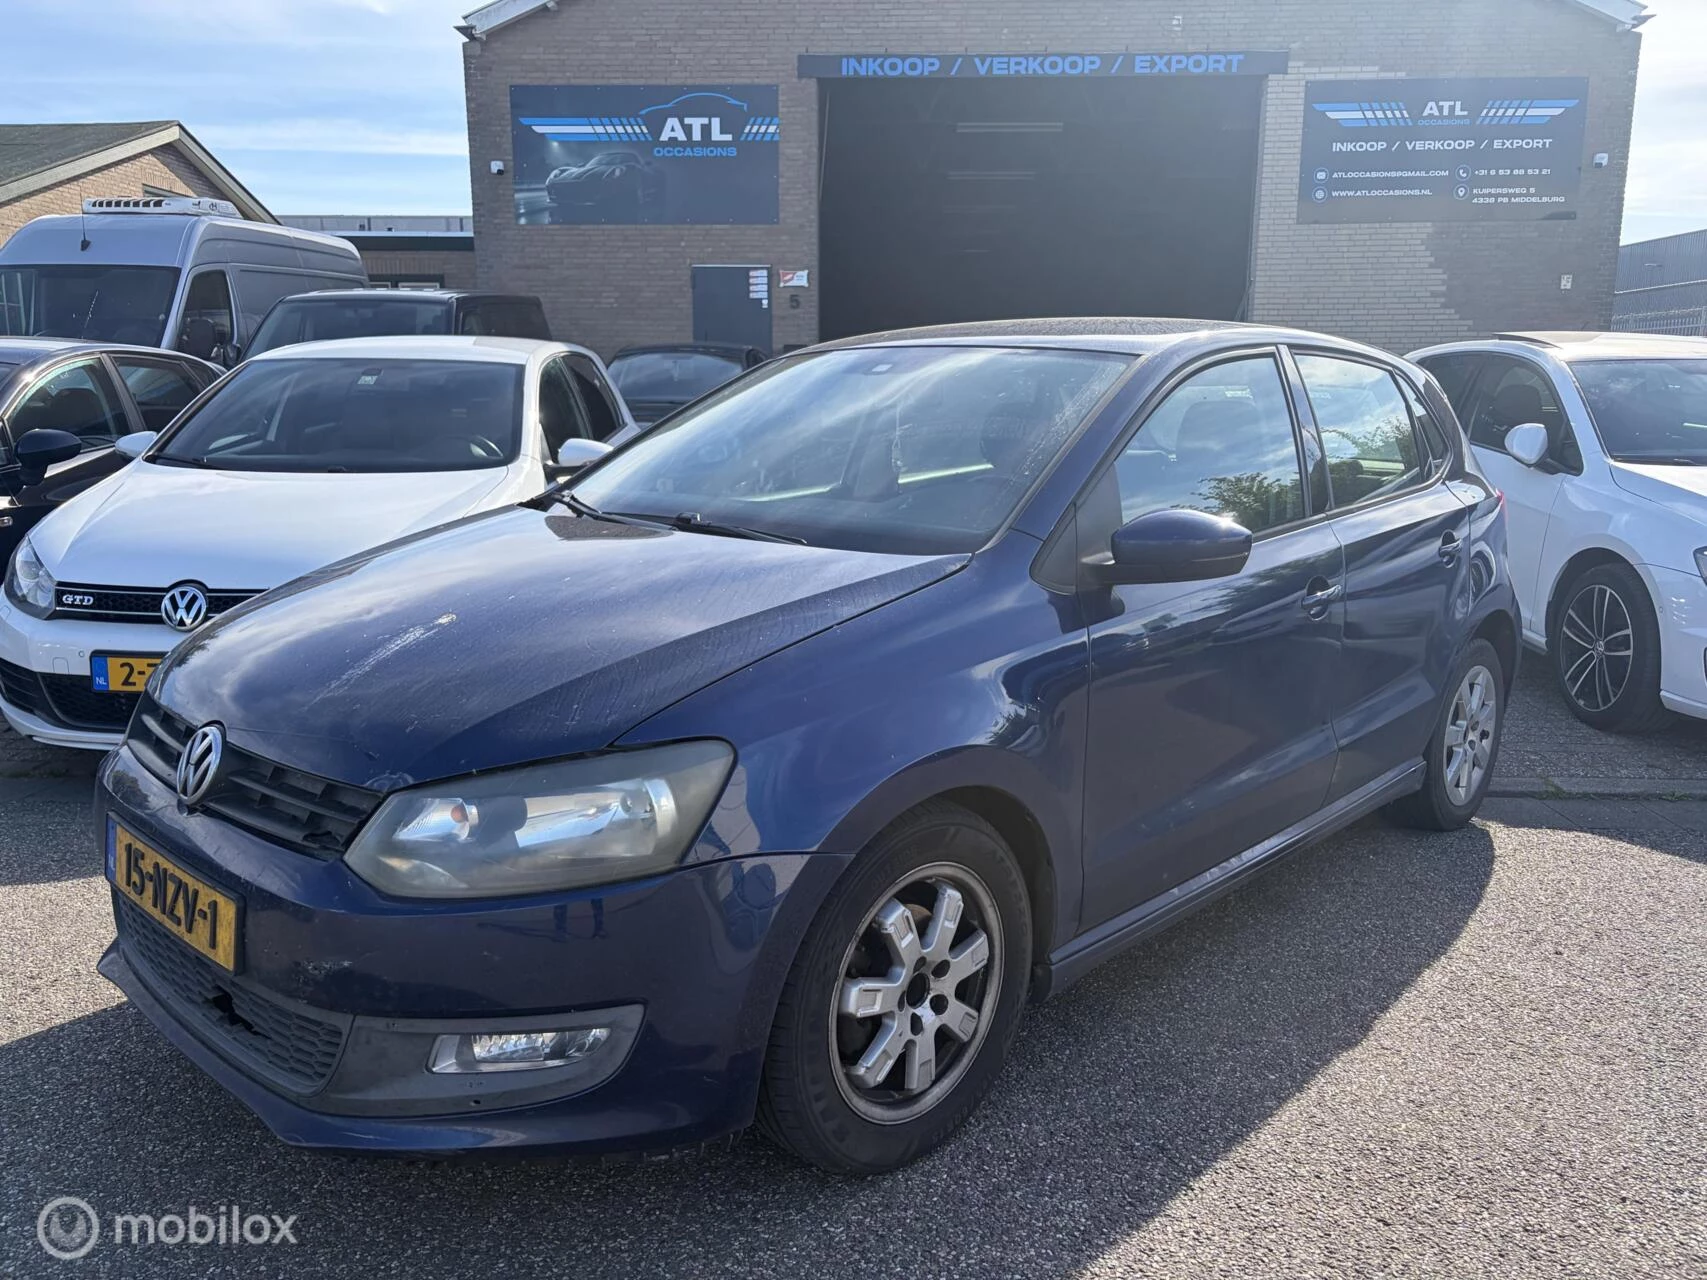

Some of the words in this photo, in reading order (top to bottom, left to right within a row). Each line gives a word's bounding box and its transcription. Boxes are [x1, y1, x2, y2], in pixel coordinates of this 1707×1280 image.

[842, 57, 940, 77] INKOOP
[950, 57, 962, 75] /
[975, 55, 1101, 75] VERKOOP
[1110, 55, 1123, 73] /
[1134, 54, 1245, 73] EXPORT
[1422, 101, 1468, 117] ATL
[1418, 118, 1471, 126] OCCASIONS
[659, 117, 733, 141] ATL
[653, 147, 737, 157] OCCASIONS
[1332, 141, 1387, 152] INKOOP
[1392, 141, 1400, 151] /
[1405, 140, 1475, 151] VERKOOP
[1480, 139, 1489, 150] /
[1493, 139, 1553, 149] EXPORT
[1331, 189, 1432, 197] WWW.ATLOCCASIONS.NL
[789, 294, 800, 309] 5
[62, 594, 94, 606] GTD
[96, 676, 107, 686] NL
[124, 841, 218, 950] 15-NZV-1
